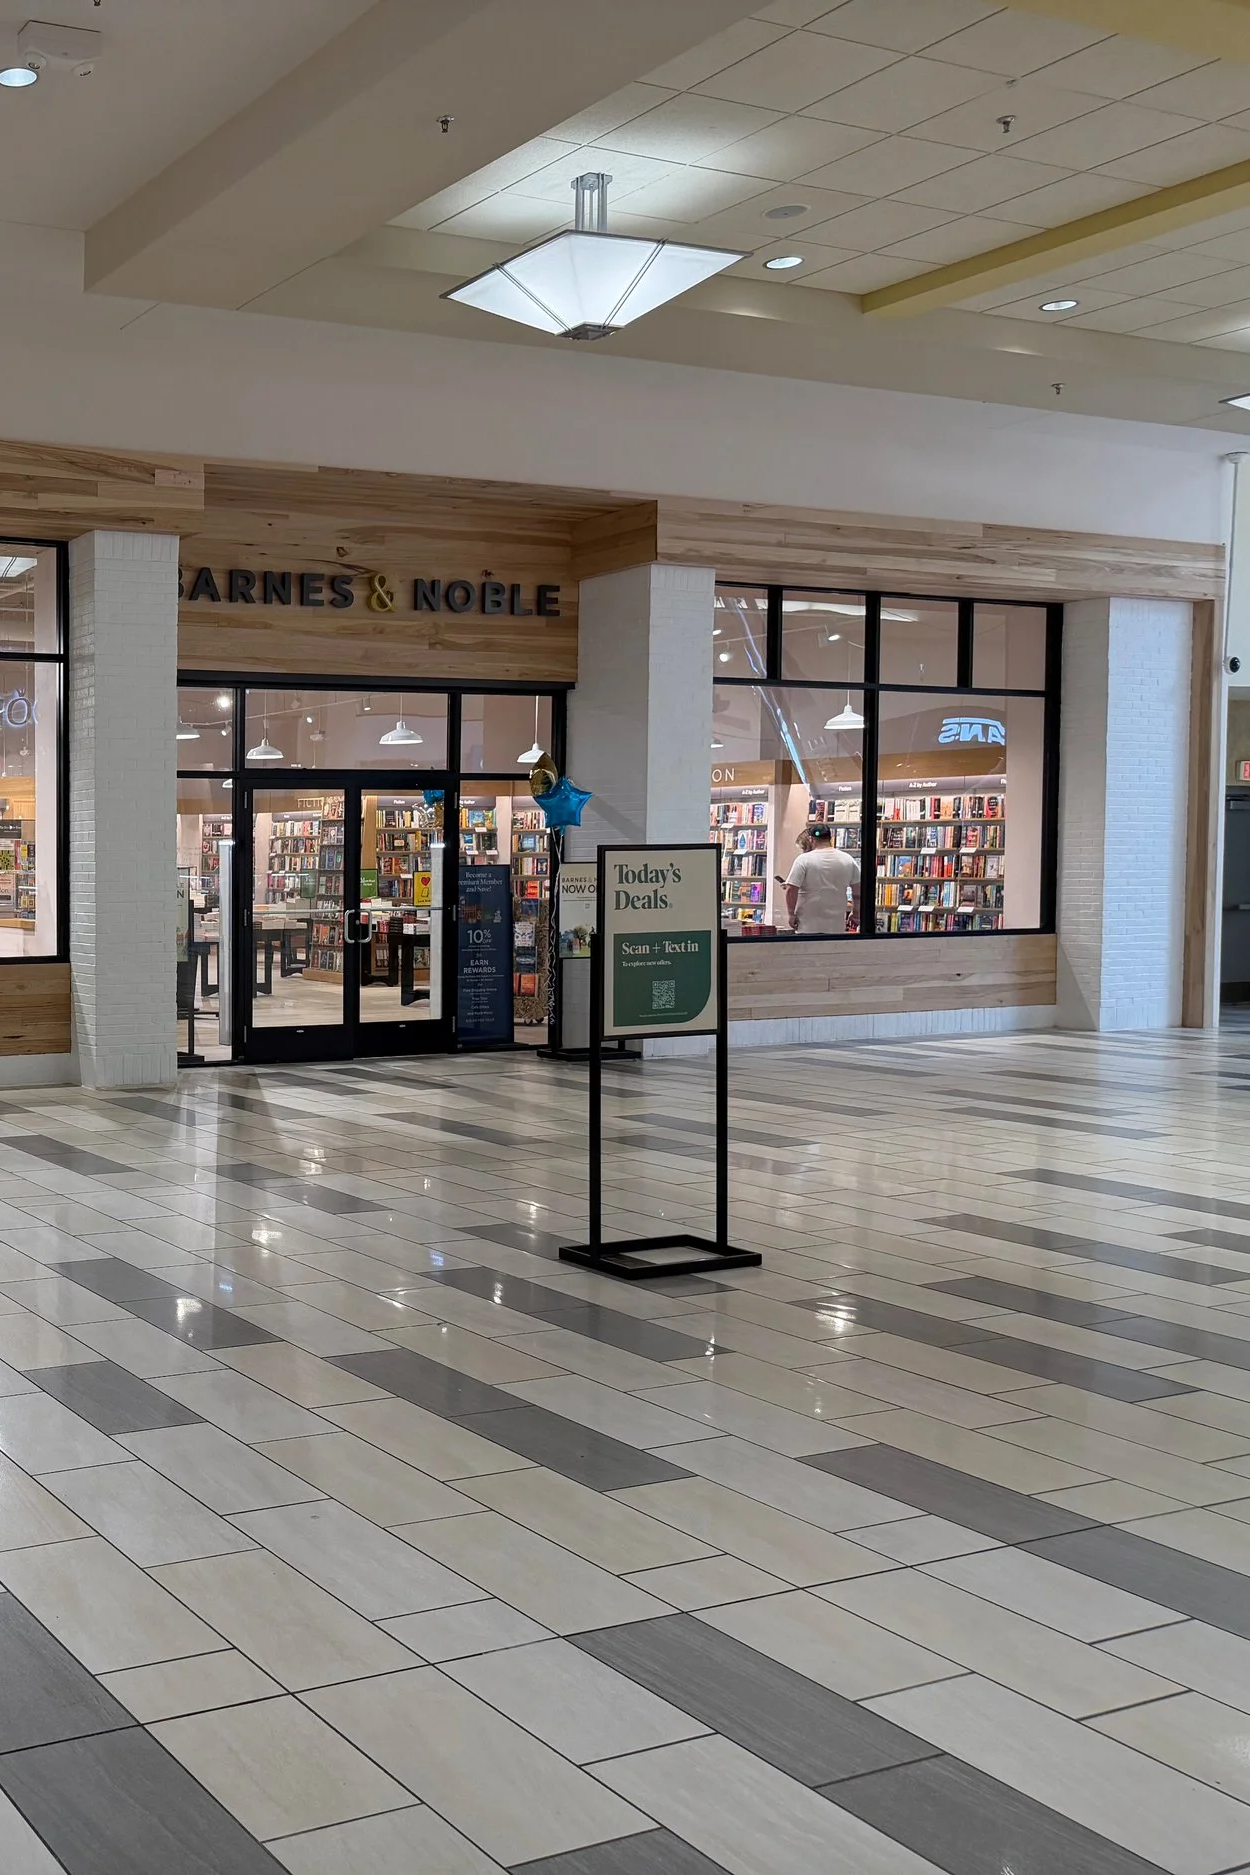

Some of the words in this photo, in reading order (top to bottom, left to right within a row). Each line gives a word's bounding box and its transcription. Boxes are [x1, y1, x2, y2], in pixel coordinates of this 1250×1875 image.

[178, 567, 355, 608] ARNES
[368, 573, 397, 613] &
[414, 578, 561, 617] NOBLE
[465, 871, 488, 879] Become
[614, 862, 682, 889] Today's
[561, 884, 586, 894] NOW
[614, 889, 674, 911] Deals.
[621, 941, 650, 955] Scan
[652, 941, 661, 954] +
[662, 940, 686, 953] Text
[687, 940, 699, 952] in
[470, 959, 489, 967] EARN
[463, 966, 497, 974] REWARDS
